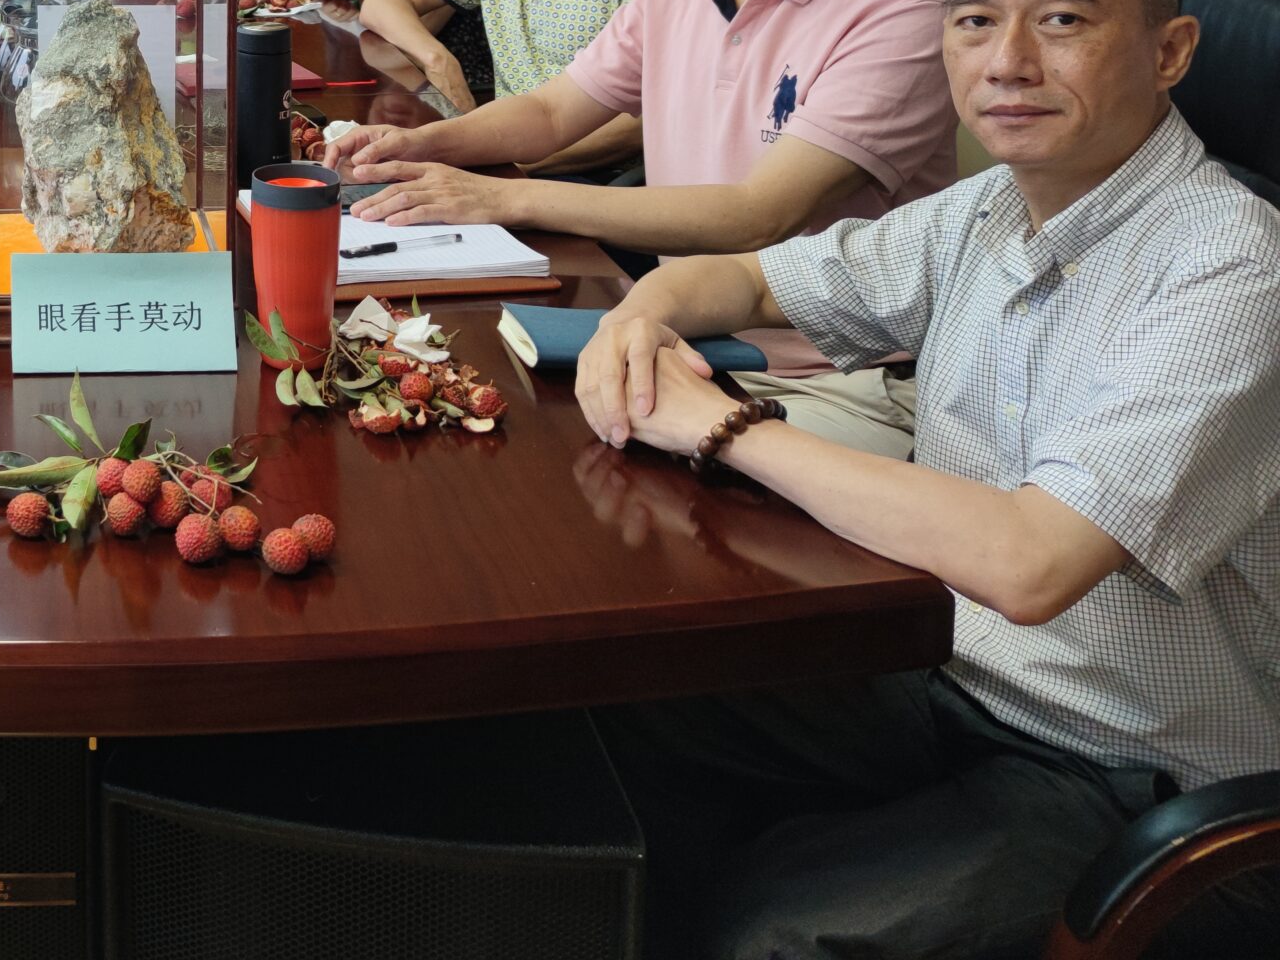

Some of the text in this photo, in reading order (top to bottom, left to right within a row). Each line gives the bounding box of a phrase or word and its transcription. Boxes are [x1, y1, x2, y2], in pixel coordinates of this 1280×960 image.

[37, 300, 203, 333] 眼看手莫动
